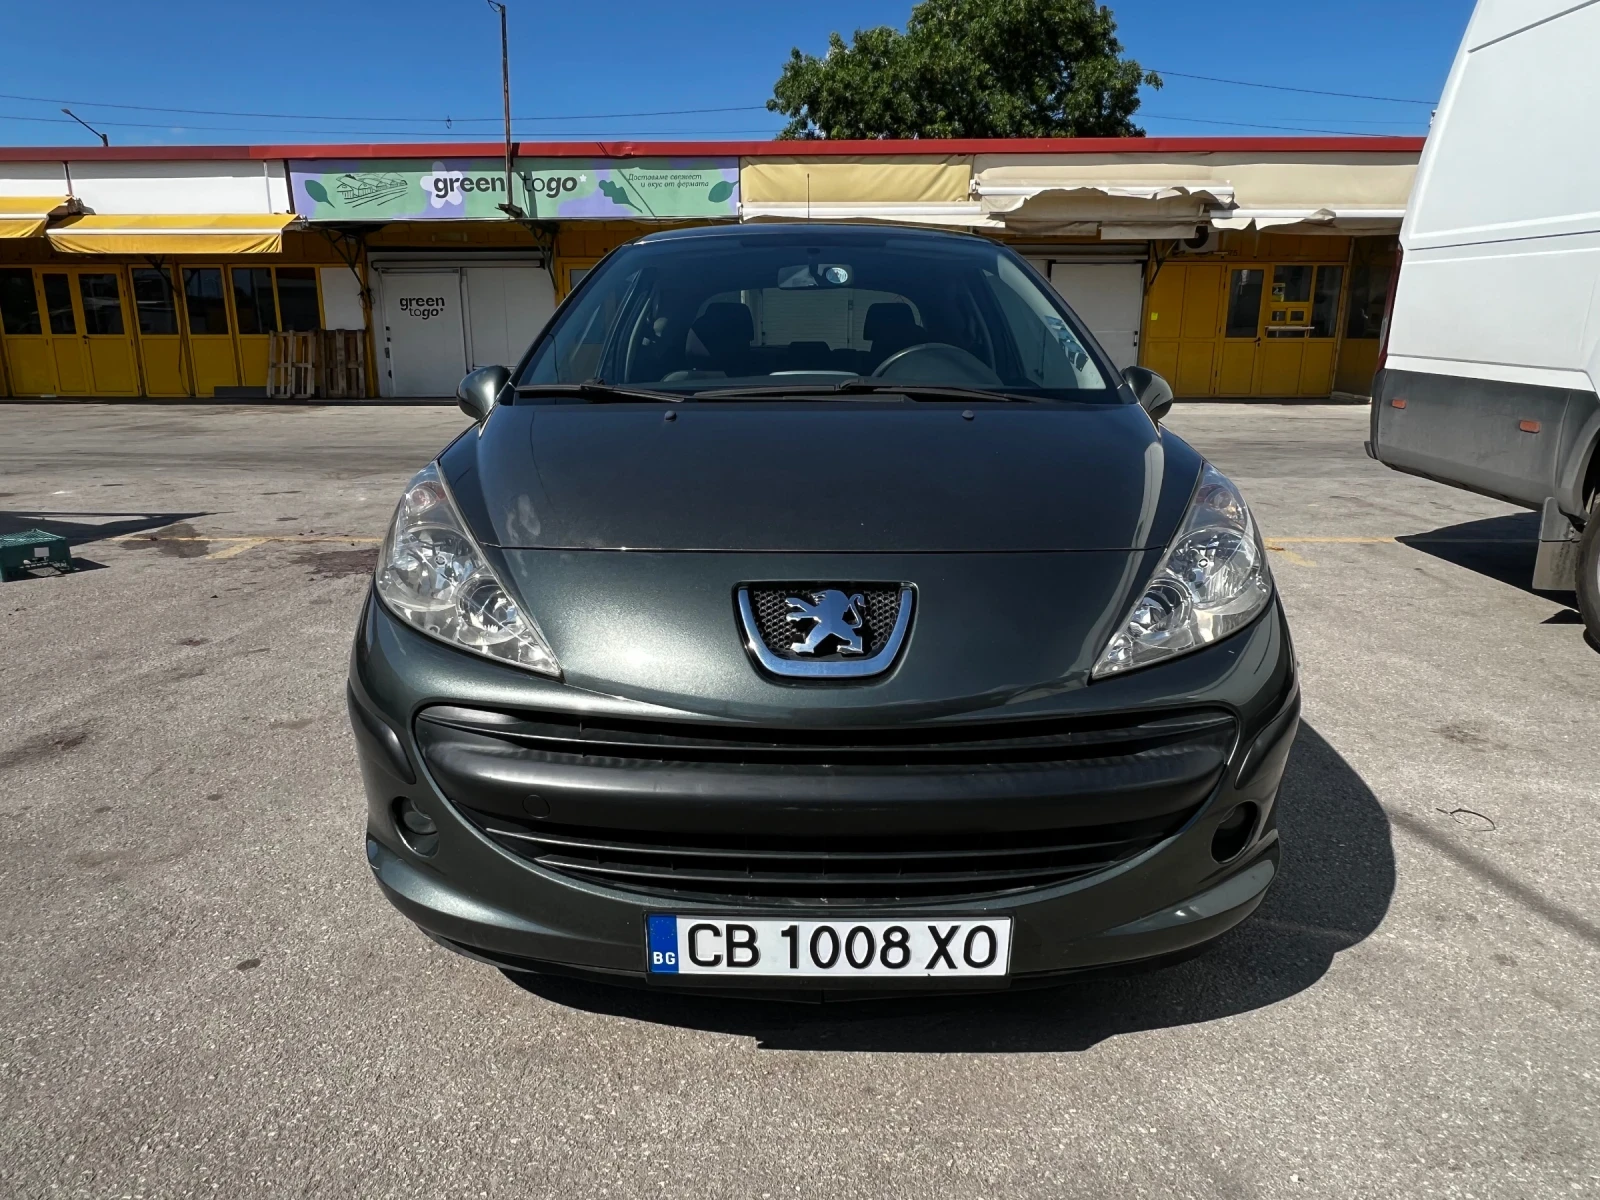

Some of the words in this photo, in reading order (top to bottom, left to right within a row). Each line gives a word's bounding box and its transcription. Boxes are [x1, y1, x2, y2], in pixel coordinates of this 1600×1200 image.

[433, 176, 506, 199] green
[677, 180, 709, 189] фермата
[399, 296, 446, 311] green
[687, 923, 761, 968] CB
[781, 924, 911, 969] 1008
[924, 925, 998, 969] XO
[653, 951, 676, 965] BG
